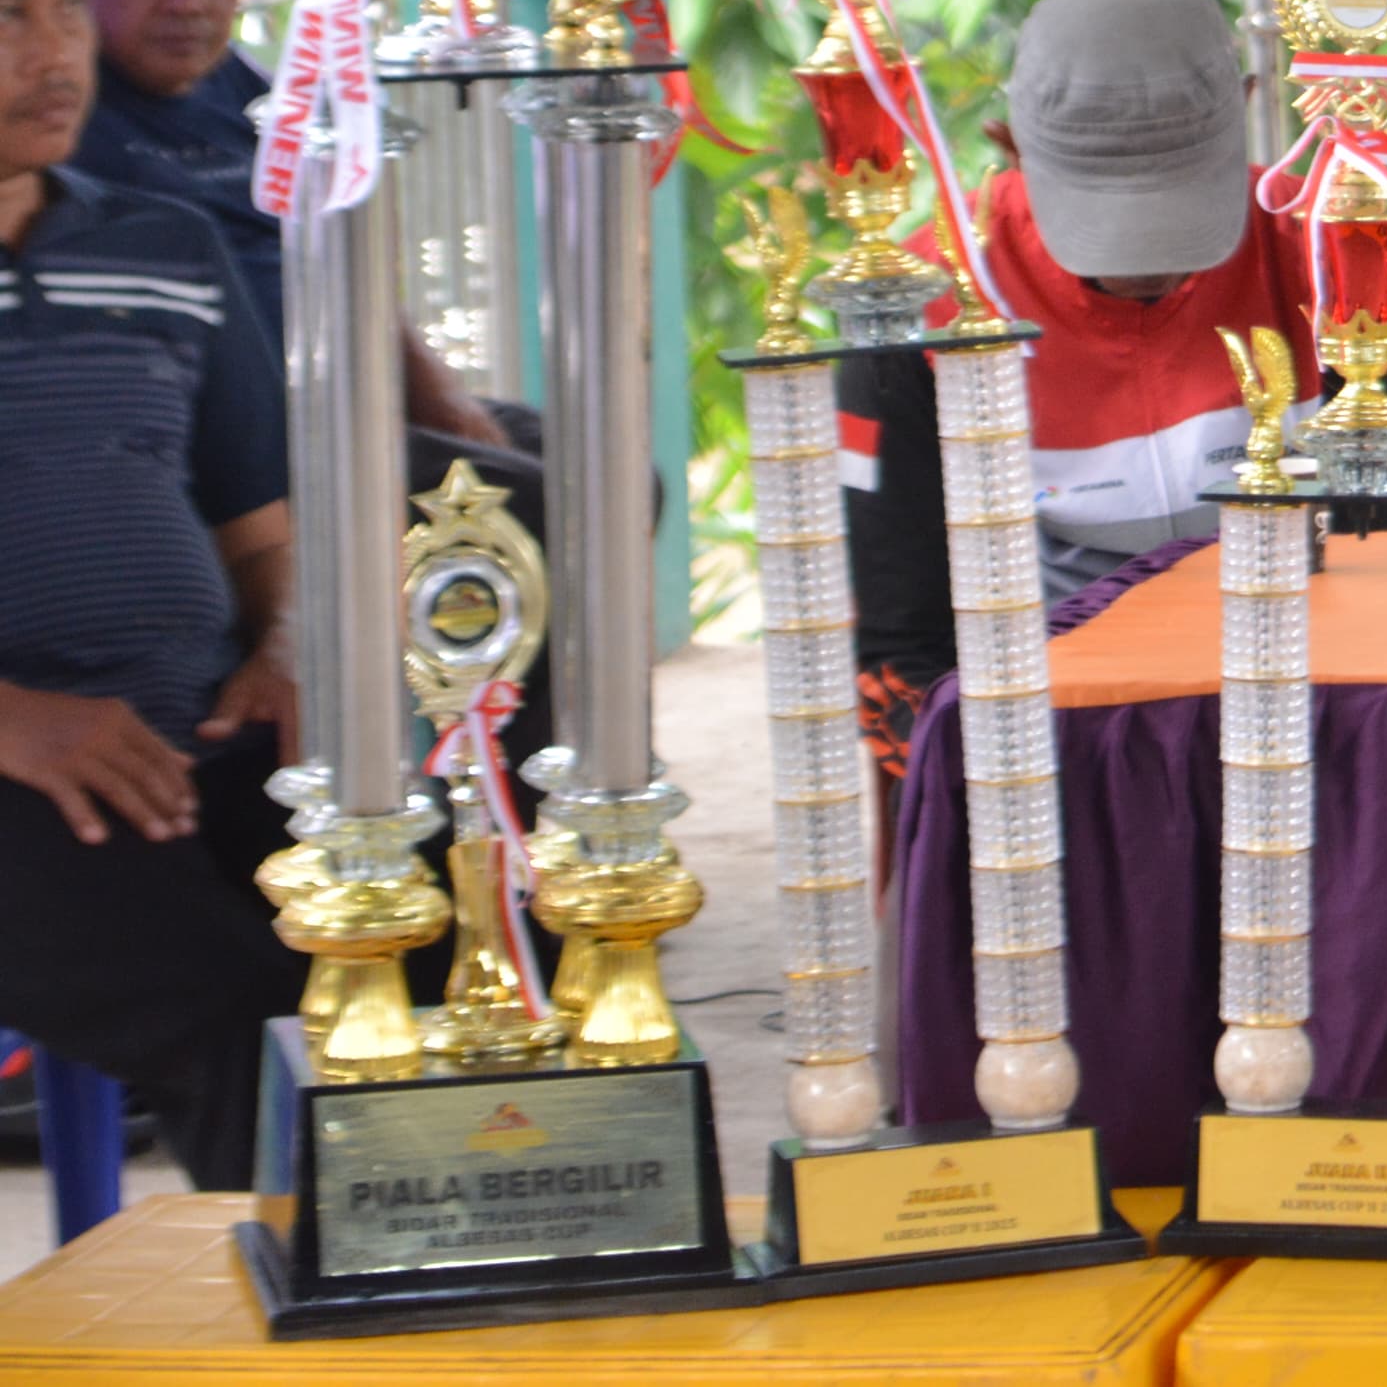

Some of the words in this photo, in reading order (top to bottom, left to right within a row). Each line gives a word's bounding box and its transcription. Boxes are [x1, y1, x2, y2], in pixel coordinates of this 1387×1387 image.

[350, 1175, 463, 1212] PIALA
[479, 1160, 664, 1201] BERGILIR
[385, 1214, 457, 1235] BIDAR
[470, 1202, 629, 1226] TRADISIONAL
[543, 1222, 591, 1240] CUP
